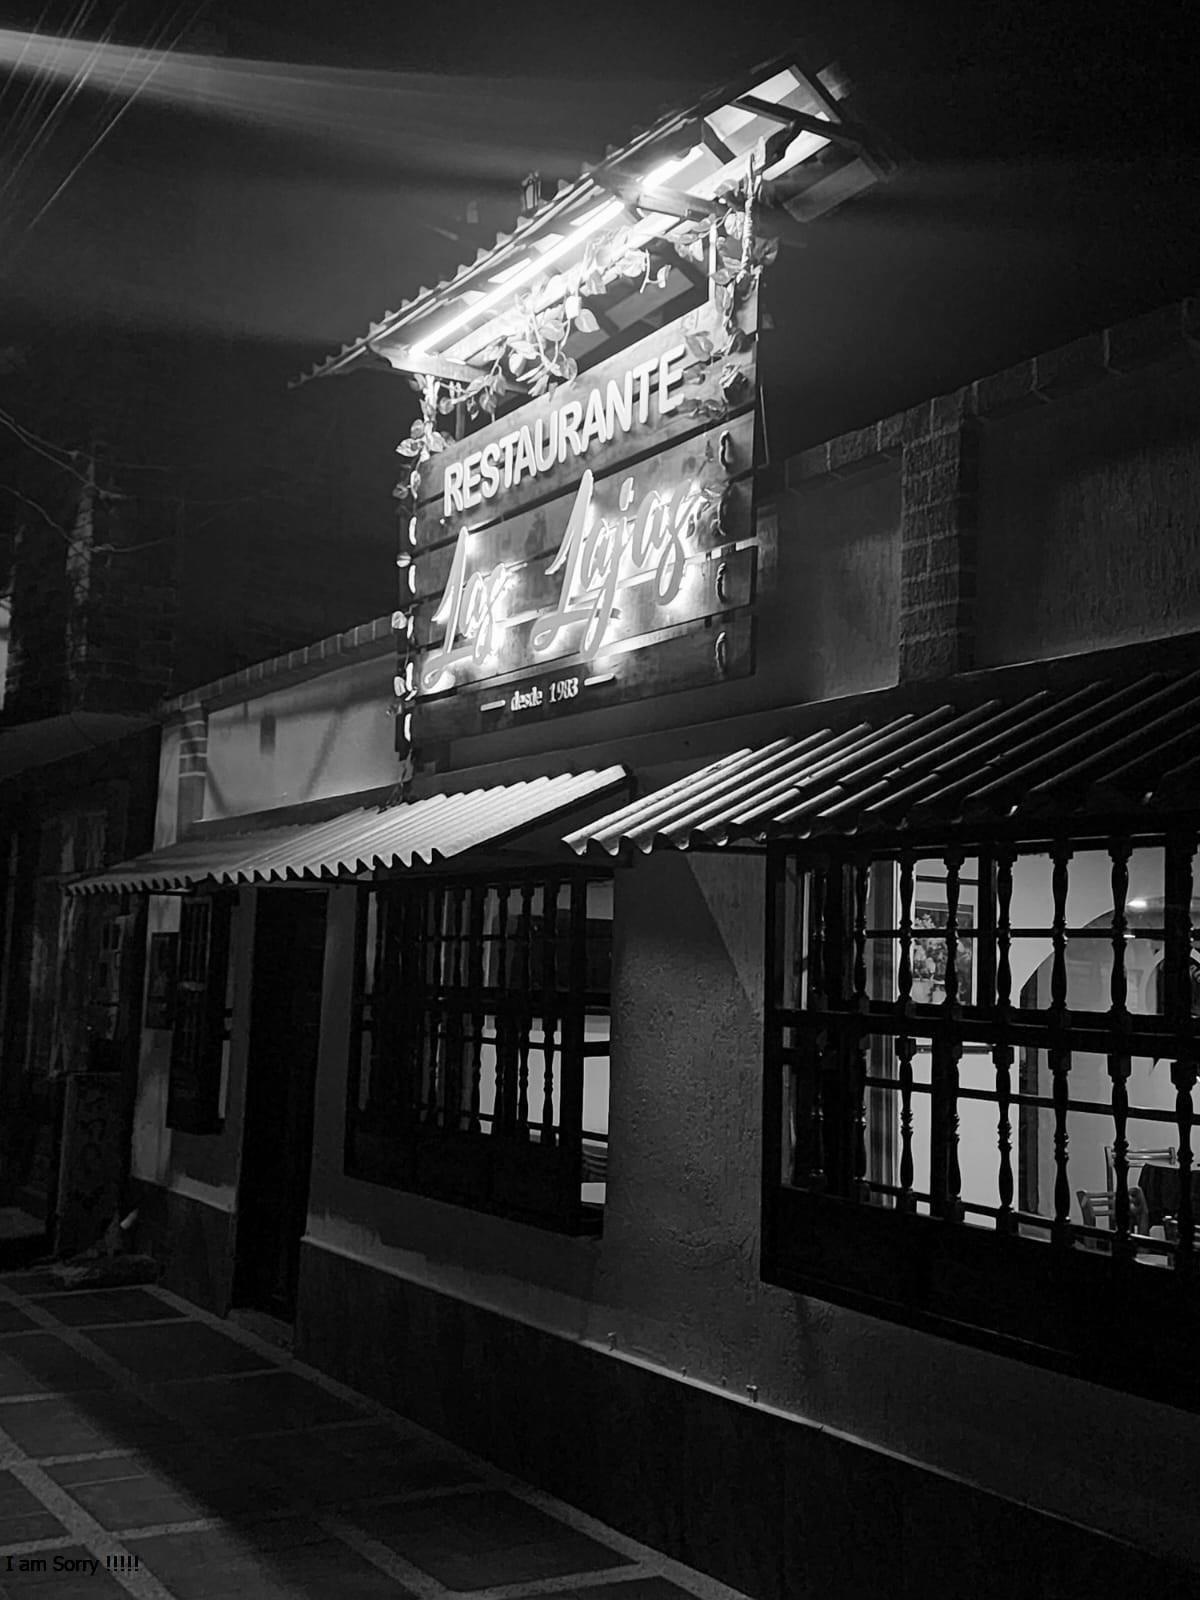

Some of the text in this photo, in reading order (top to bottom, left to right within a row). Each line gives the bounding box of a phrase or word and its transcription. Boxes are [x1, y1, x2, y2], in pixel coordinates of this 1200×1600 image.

[443, 344, 686, 517] RESTAURANTE
[421, 469, 693, 690] Las Lajas
[510, 677, 579, 711] desde 1983
